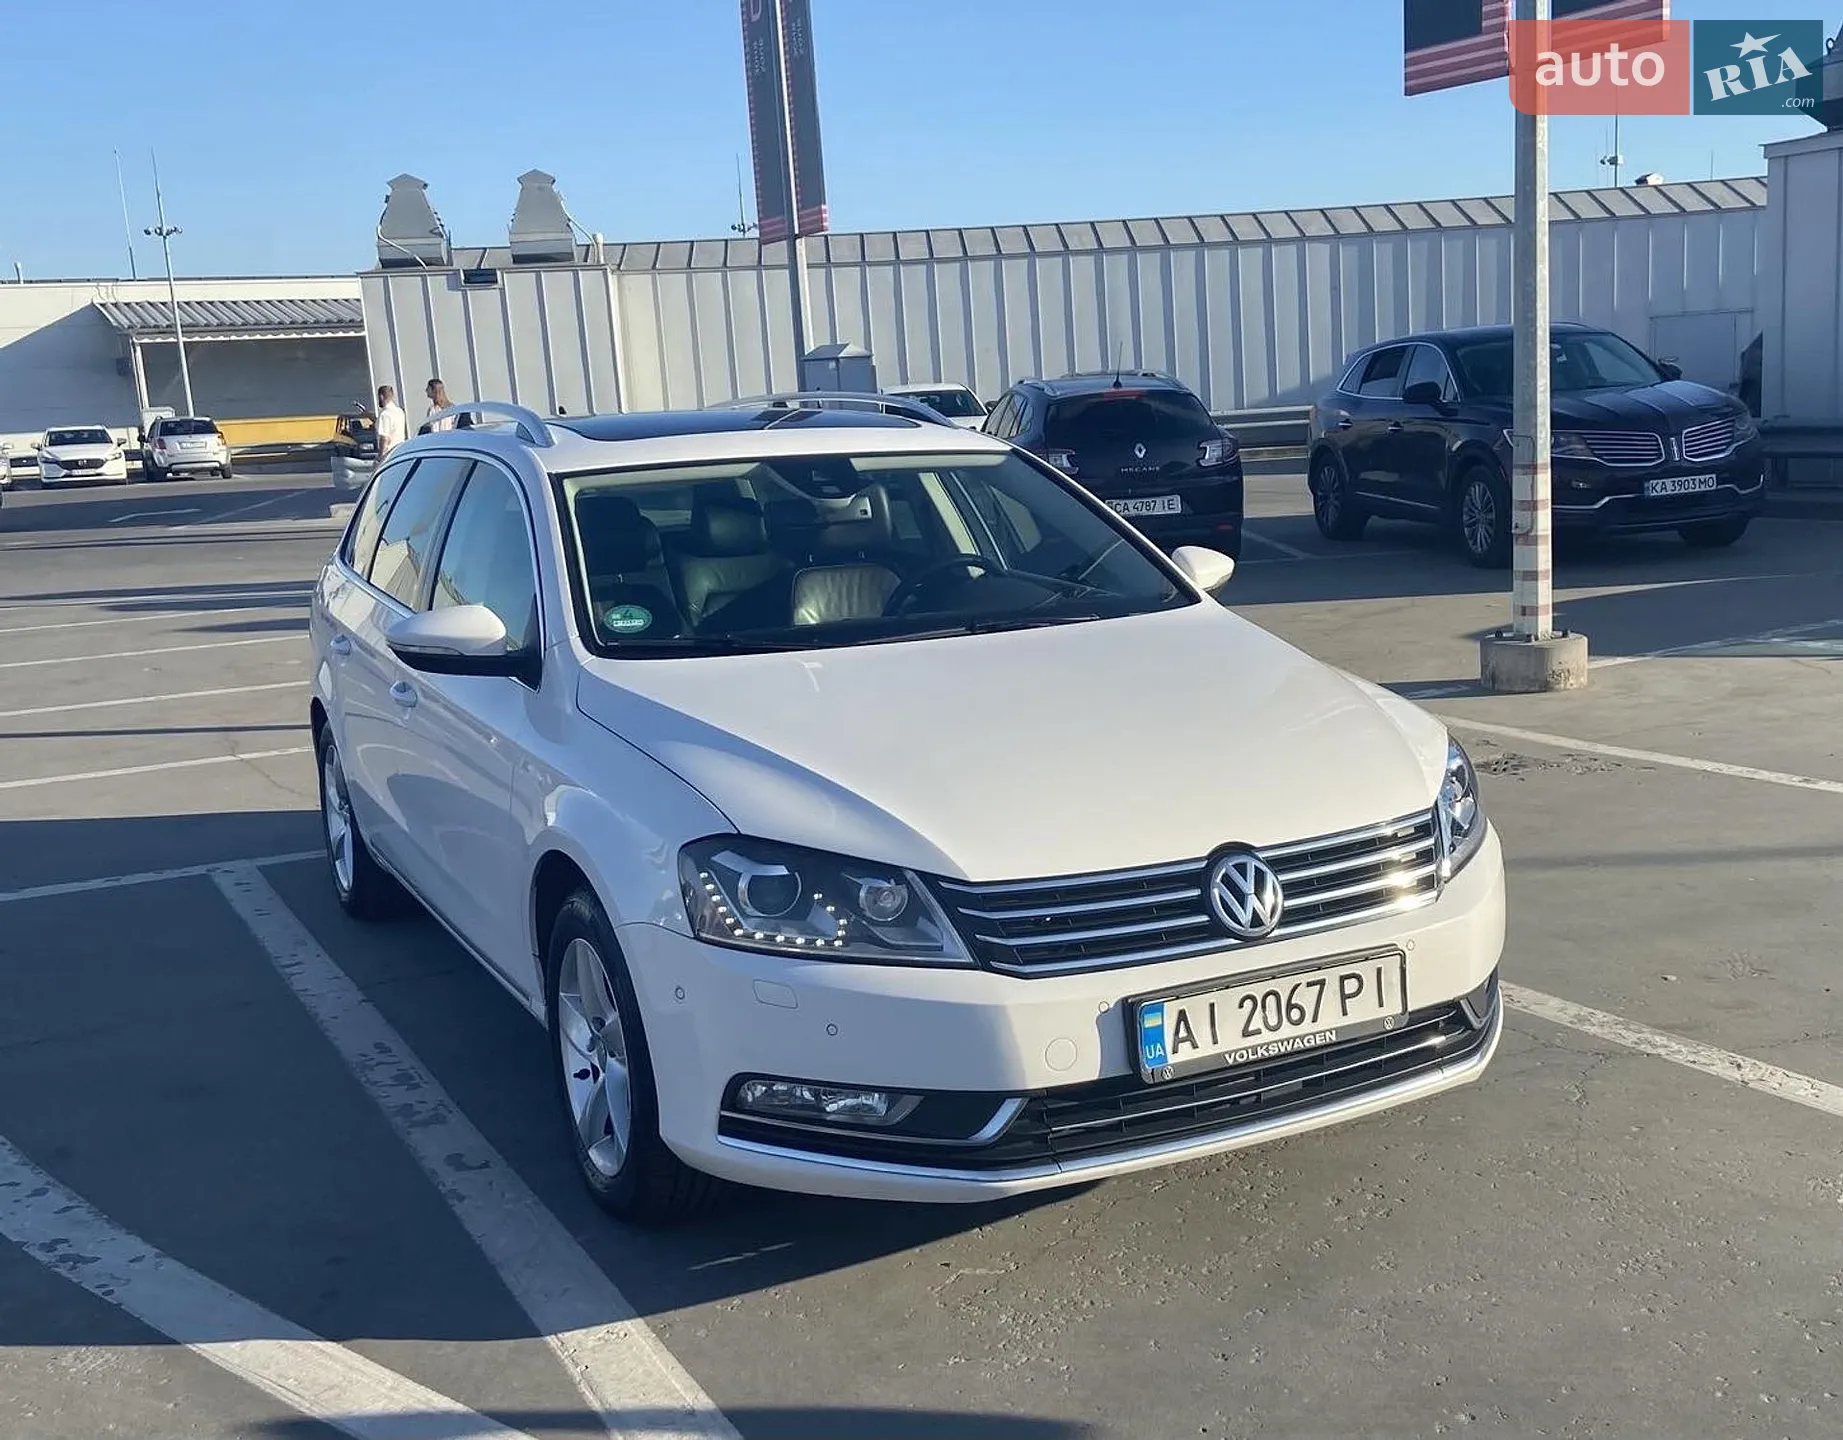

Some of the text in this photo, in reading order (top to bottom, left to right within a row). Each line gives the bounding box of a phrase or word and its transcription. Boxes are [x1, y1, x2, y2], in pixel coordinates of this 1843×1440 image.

[1651, 476, 1715, 494] KA 3903 MO
[1132, 500, 1157, 512] 4787
[1162, 498, 1176, 510] IE
[1172, 966, 1384, 1054] AI 2067 PI
[1146, 1042, 1165, 1059] UA
[1224, 1030, 1337, 1065] VOLKSWAGEN
